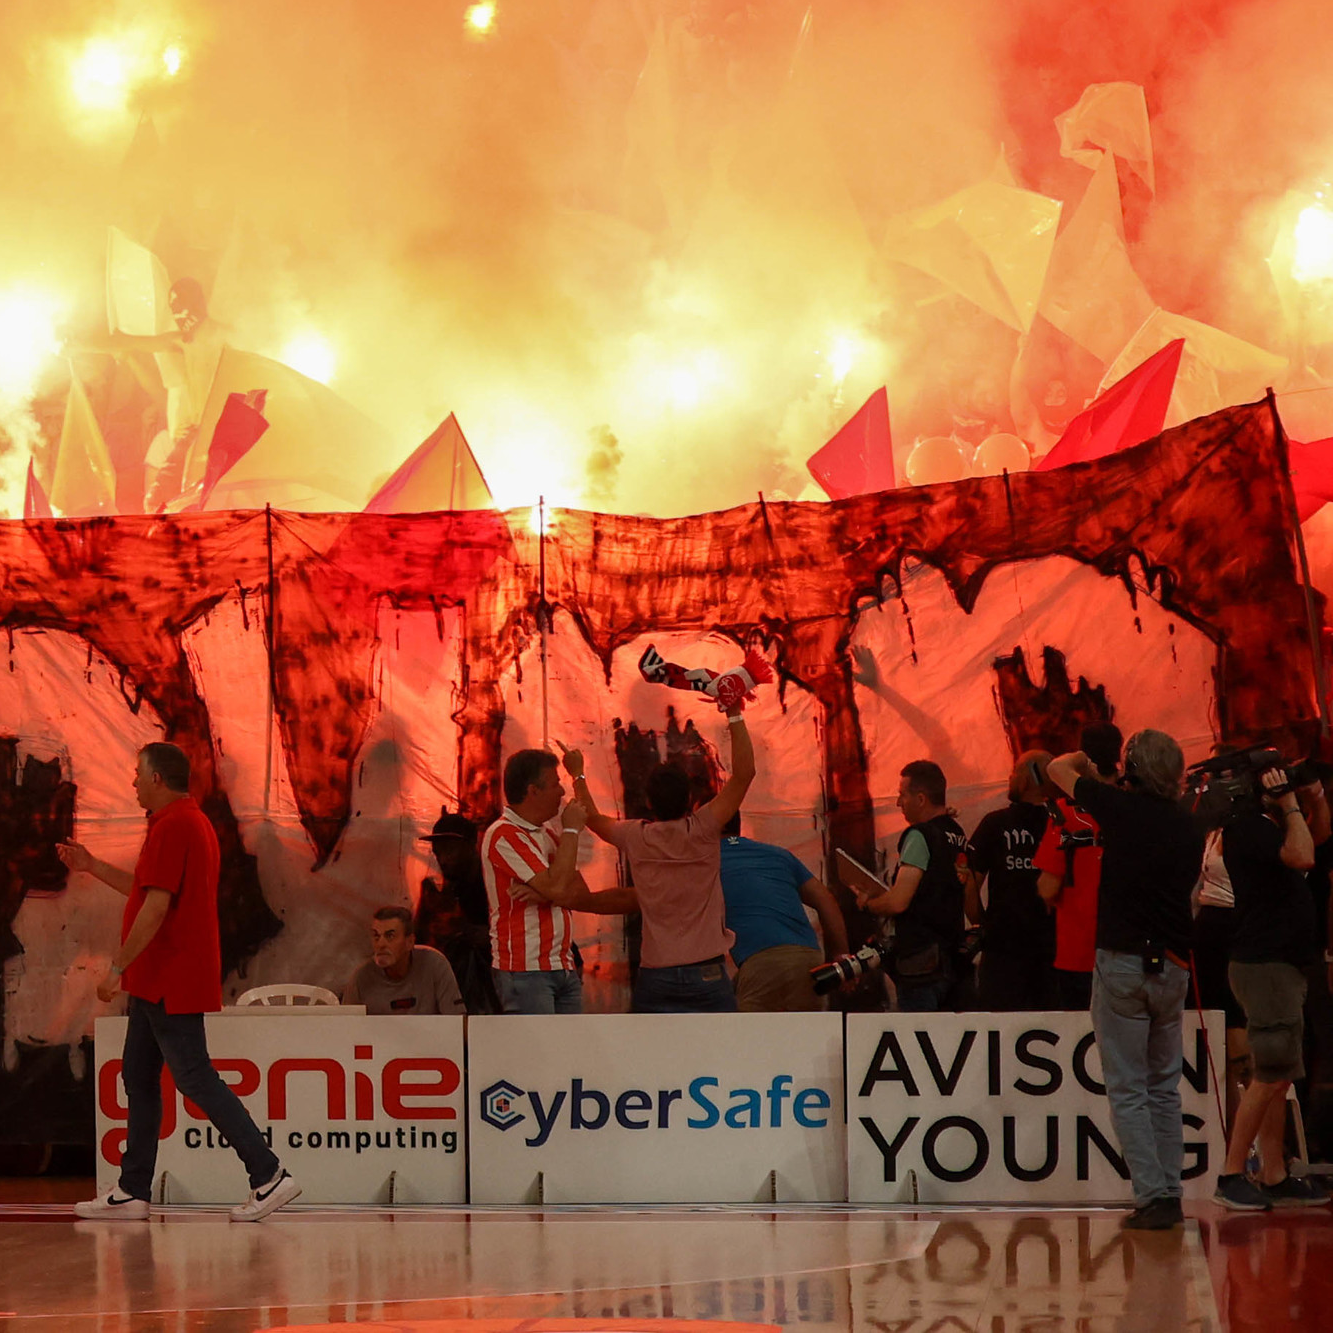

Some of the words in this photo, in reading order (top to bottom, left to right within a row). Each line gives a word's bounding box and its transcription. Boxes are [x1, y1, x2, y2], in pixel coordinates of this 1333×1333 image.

[1003, 828, 1035, 850] חון
[480, 1074, 831, 1148] CyberSafe
[184, 1126, 273, 1149] Clod
[288, 1126, 458, 1154] computing
